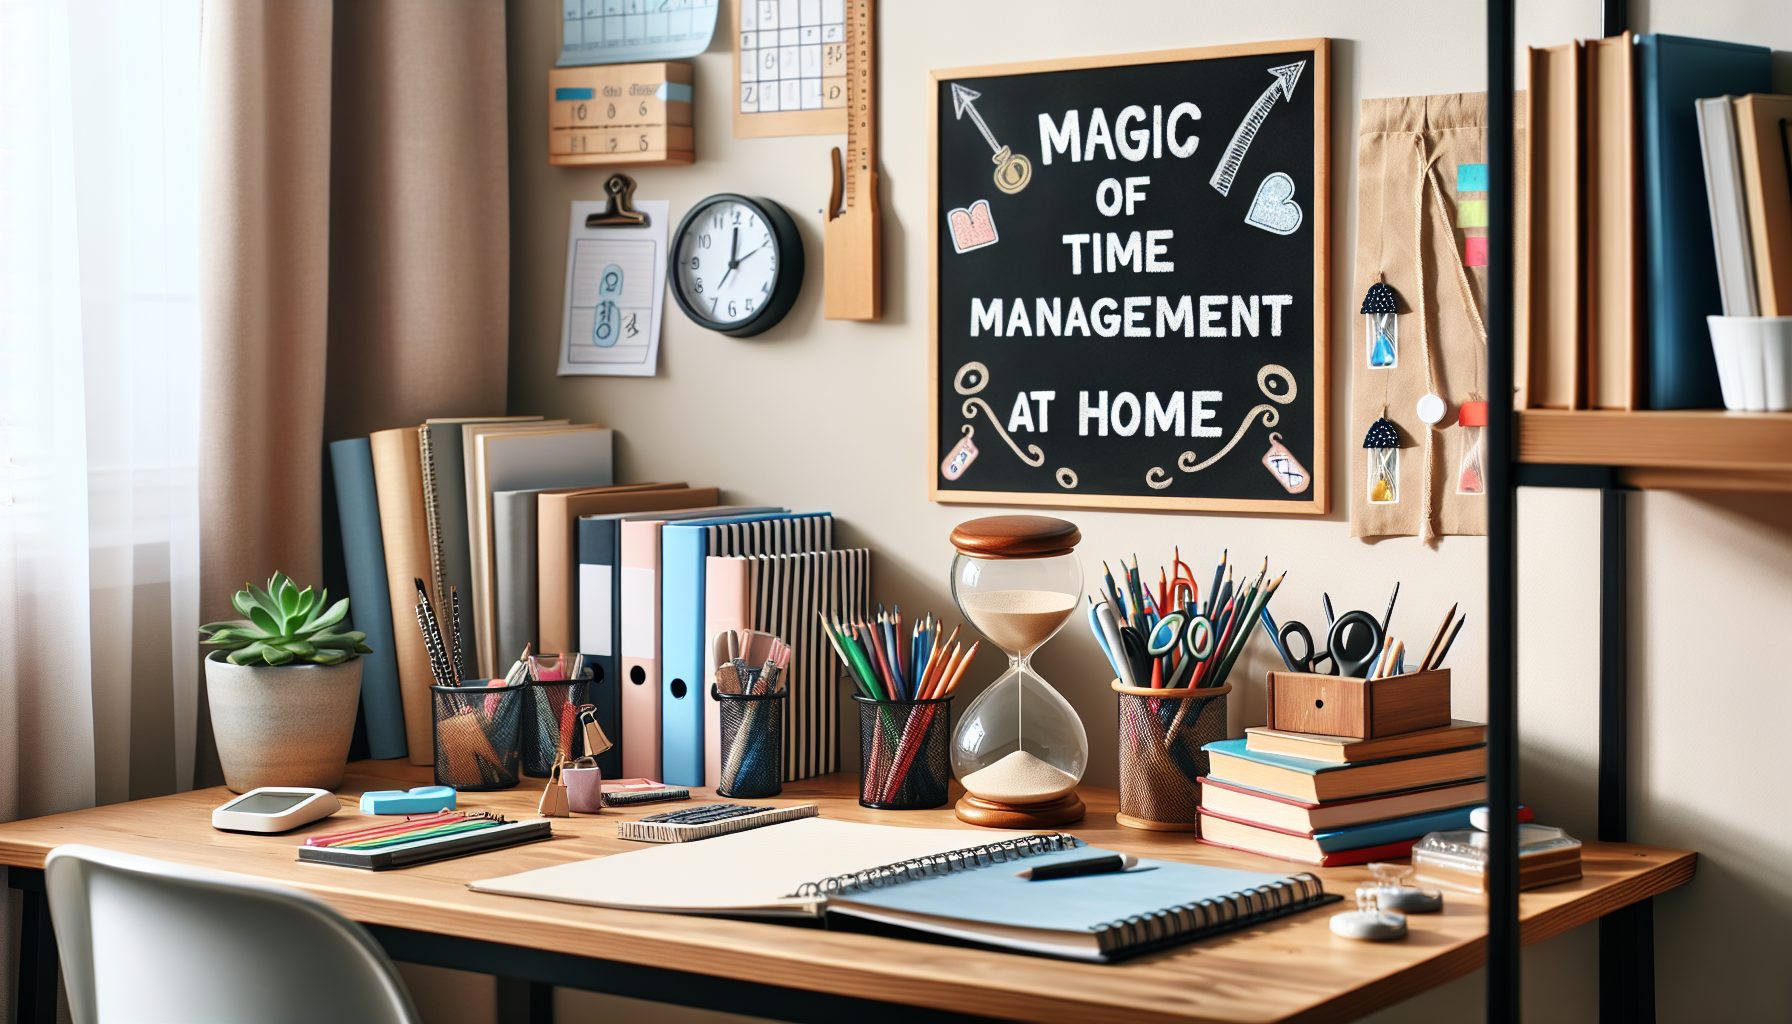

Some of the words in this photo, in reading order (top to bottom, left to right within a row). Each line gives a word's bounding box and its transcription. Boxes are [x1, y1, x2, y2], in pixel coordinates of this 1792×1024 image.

[1039, 102, 1201, 165] MAGIC
[1096, 175, 1151, 216] OF
[1062, 230, 1174, 275] TIME
[970, 295, 1293, 337] MANAGEMENT
[1008, 391, 1055, 432] AT
[1079, 391, 1223, 438] HOME
